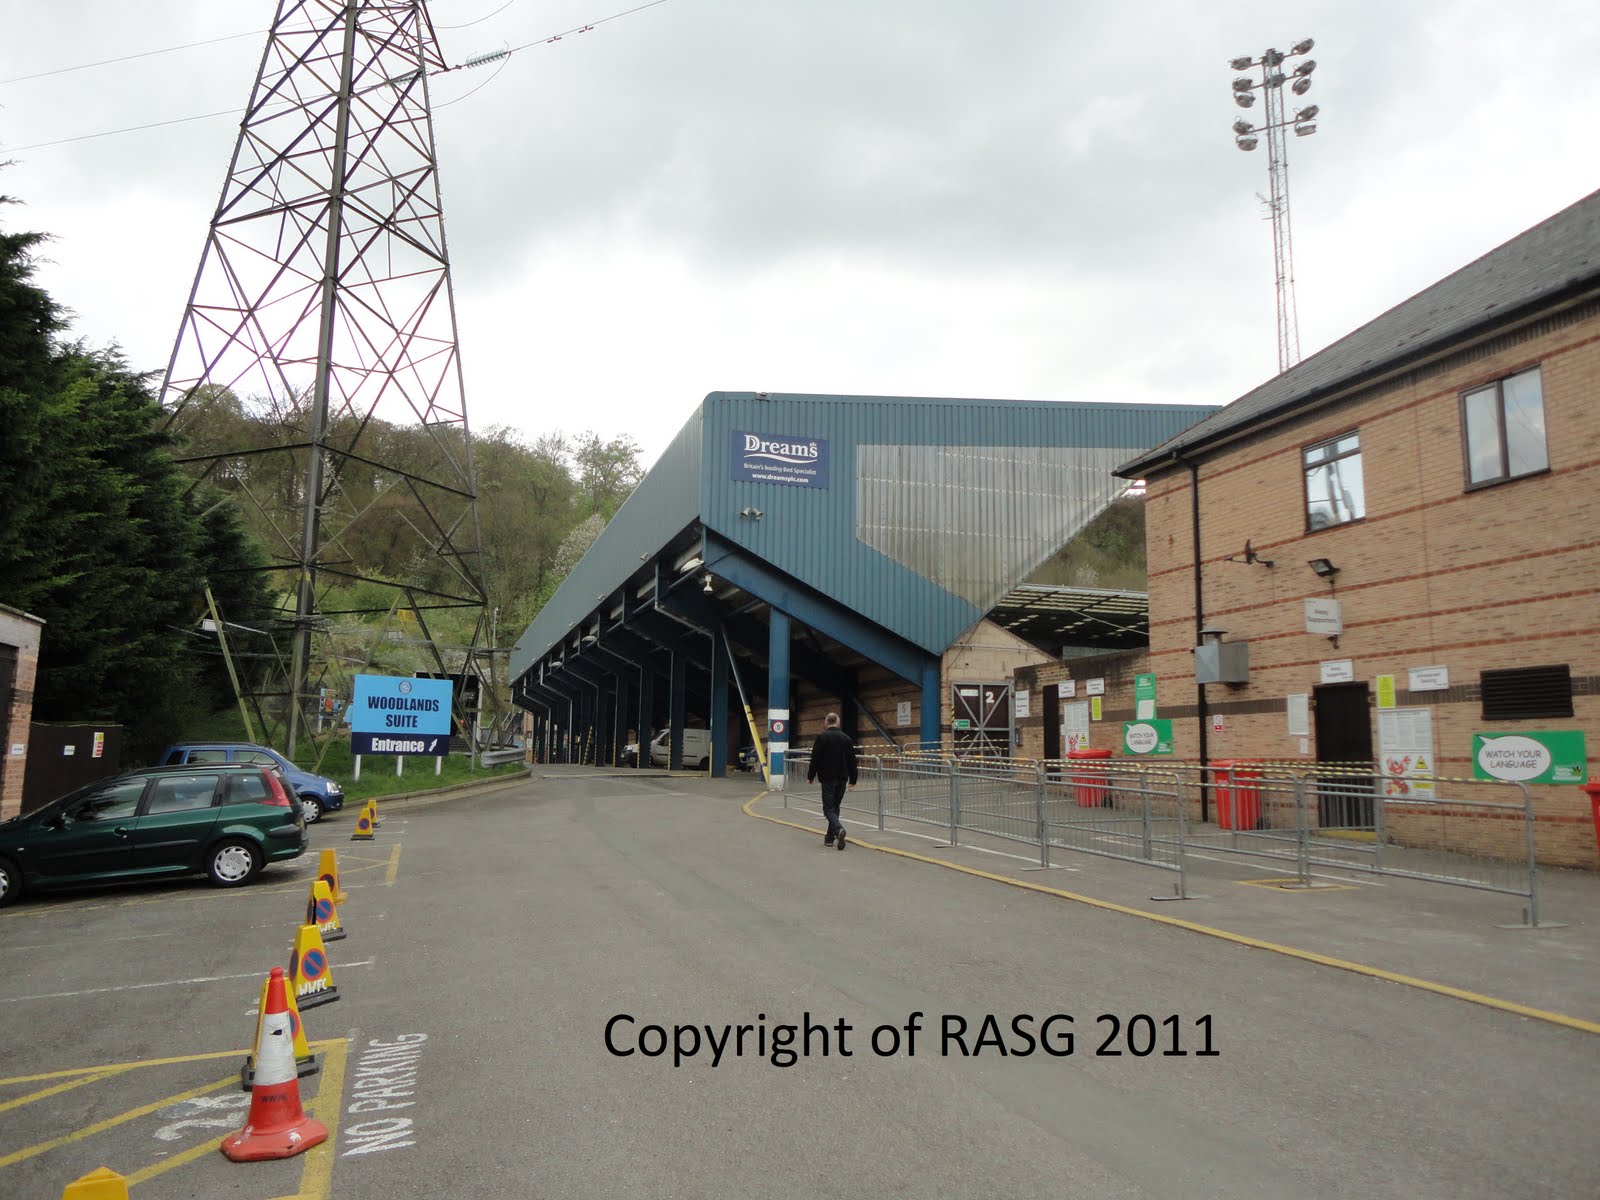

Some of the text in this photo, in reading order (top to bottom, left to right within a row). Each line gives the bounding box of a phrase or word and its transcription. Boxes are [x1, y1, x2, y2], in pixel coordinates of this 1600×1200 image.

[744, 434, 818, 458] Dreams
[752, 473, 808, 483] www.dreamsplc.com
[368, 696, 440, 712] WOODLANDS
[985, 691, 995, 704] 2
[386, 714, 418, 728] SUITE
[371, 737, 425, 753] Entrance
[1485, 750, 1542, 759] WATCH YOUR
[1490, 760, 1537, 769] LANGUAGE
[298, 978, 328, 996] WWFC
[342, 1033, 428, 1156] NO PARKING
